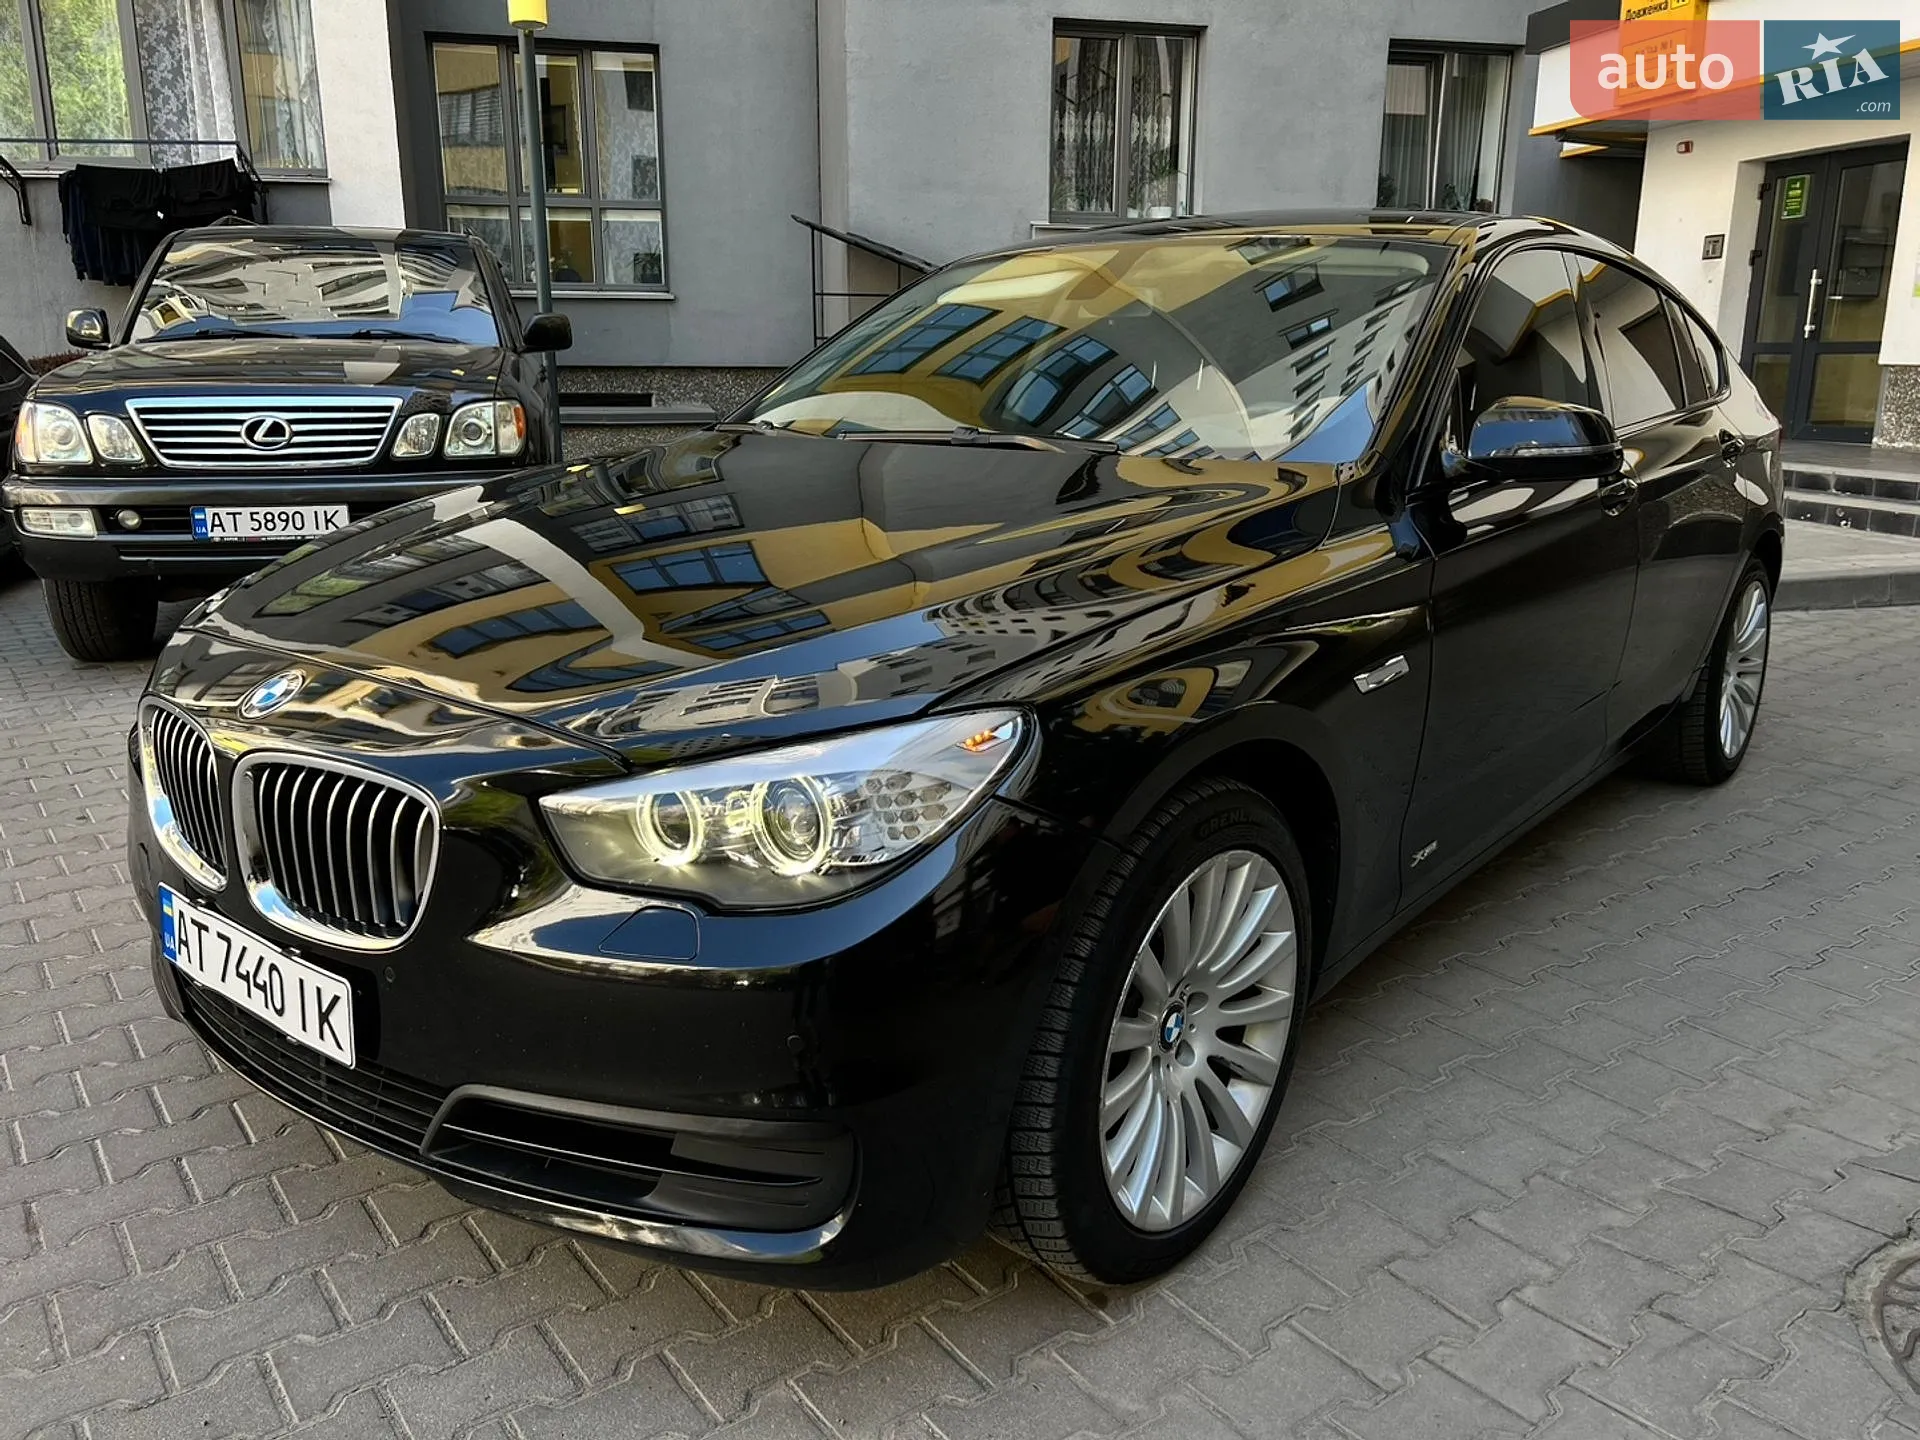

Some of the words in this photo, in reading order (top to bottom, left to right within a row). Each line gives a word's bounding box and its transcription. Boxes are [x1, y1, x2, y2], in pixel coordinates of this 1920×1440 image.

[210, 511, 242, 533] AT
[250, 510, 305, 532] 5890
[314, 509, 340, 531] IK
[165, 931, 176, 950] UA
[178, 909, 209, 972] AT
[216, 930, 285, 1018] 7440
[299, 977, 344, 1052] IK
